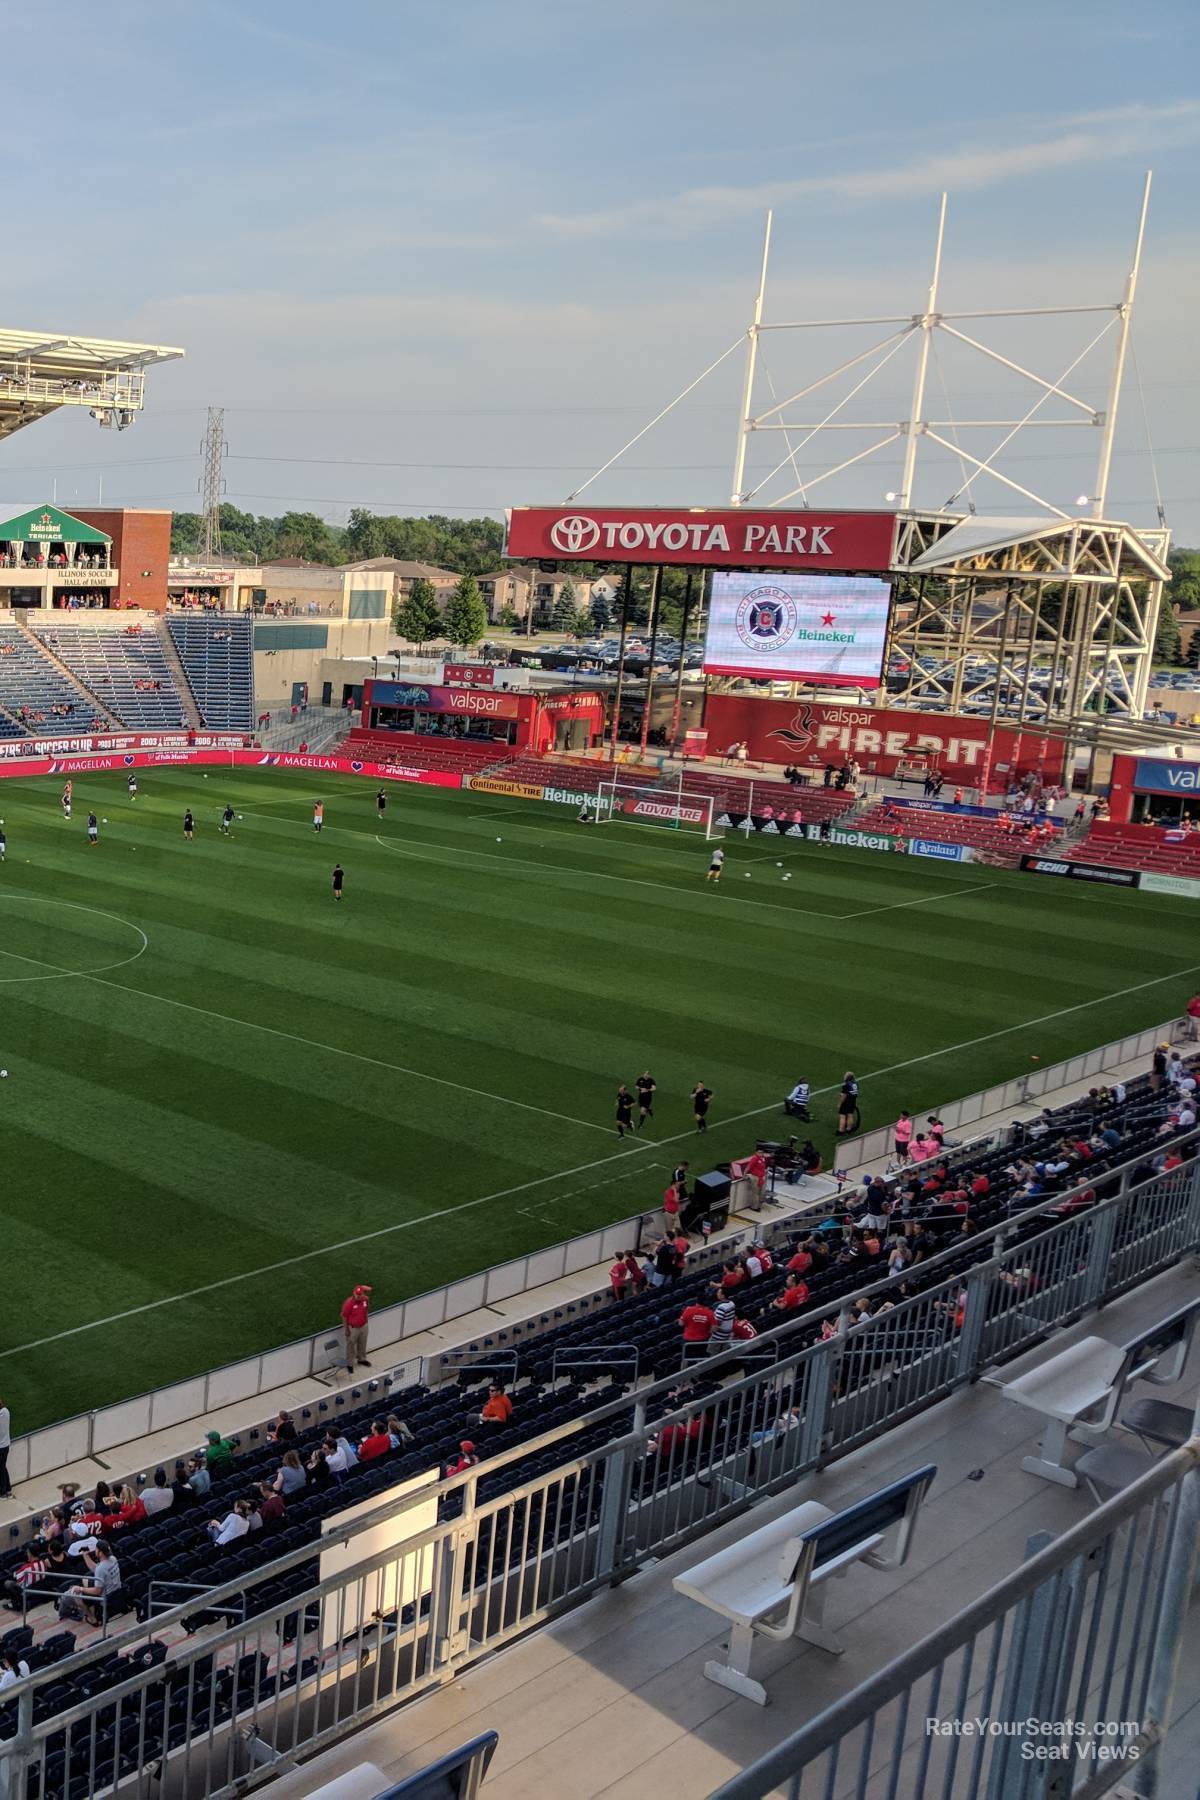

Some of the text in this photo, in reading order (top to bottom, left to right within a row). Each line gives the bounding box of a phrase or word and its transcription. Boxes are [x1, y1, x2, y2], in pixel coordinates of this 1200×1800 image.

[602, 522, 834, 555] TOYOTA PARK
[58, 570, 113, 578] ILLINOIS SOCCER
[798, 628, 855, 643] Heineken
[450, 690, 502, 713] valspar
[821, 706, 876, 726] valspar
[141, 738, 157, 746] 2003
[816, 723, 987, 766] FIRE PIT
[68, 760, 112, 770] MAGELLAN
[284, 756, 338, 769] MAGELLAN
[469, 777, 541, 796] Continental TIRE
[543, 787, 609, 810] Heineken
[633, 801, 703, 822] ADVOCARE
[1035, 861, 1070, 874] ECHO
